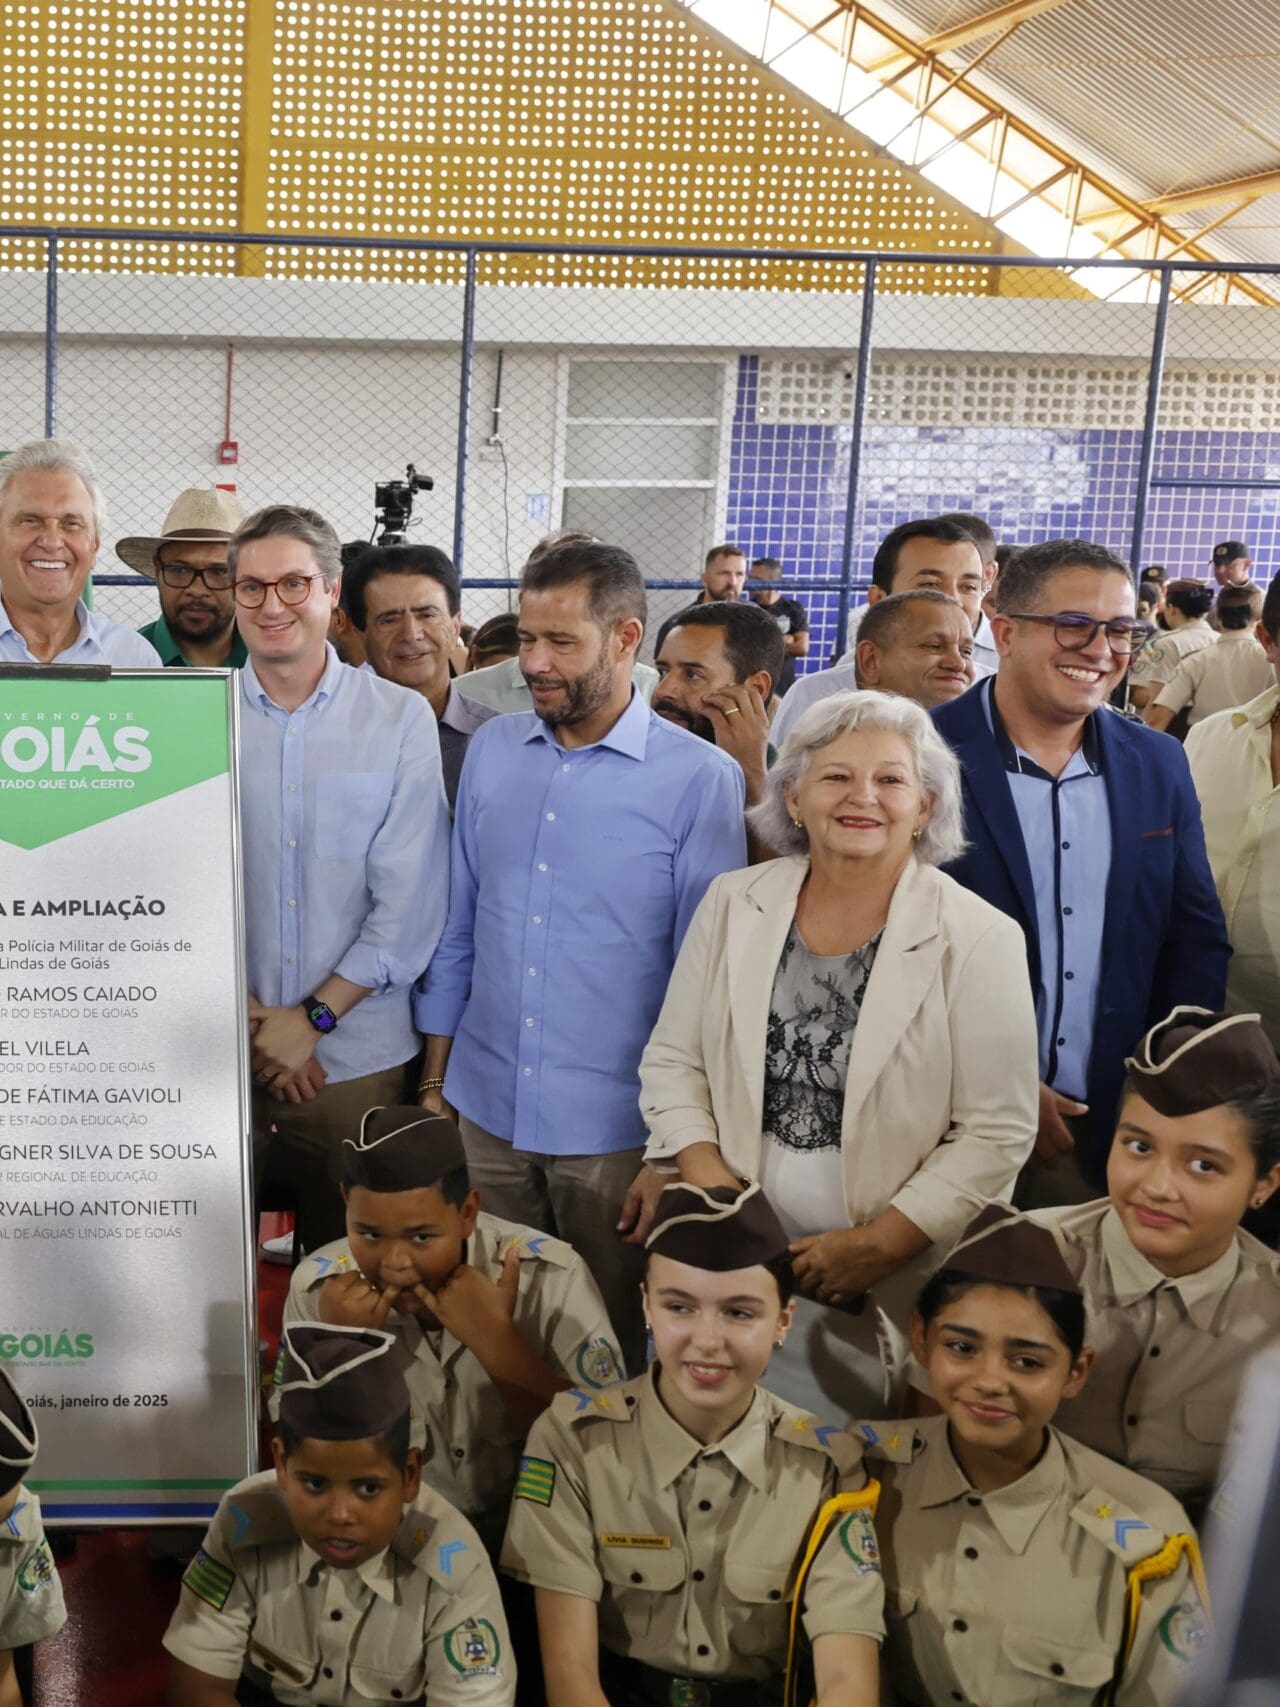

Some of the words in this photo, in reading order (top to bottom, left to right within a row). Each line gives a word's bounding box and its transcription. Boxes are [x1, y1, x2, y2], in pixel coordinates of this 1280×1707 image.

[110, 712, 134, 721] DE
[39, 779, 67, 790] QUE
[69, 778, 87, 789] DÁ
[91, 779, 135, 789] CERTO
[13, 900, 25, 917] E
[31, 896, 165, 920] AMPLIAÇÃO
[9, 939, 55, 953] Polícia
[59, 939, 104, 953] Militar
[108, 939, 126, 953] de
[130, 939, 170, 953] Goiás
[174, 939, 192, 953] de
[49, 957, 67, 970] de
[71, 957, 110, 970] Goiás
[7, 986, 78, 1002] RAMOS
[84, 986, 157, 1002] CAIADO
[12, 1009, 30, 1019] DO
[34, 1009, 80, 1019] ESTADO
[84, 1009, 98, 1019] DE
[102, 1007, 138, 1019] GOIÁS
[25, 1041, 89, 1056] VILELA
[27, 1063, 46, 1073] DO
[49, 1063, 95, 1073] ESTADO
[100, 1063, 114, 1073] DE
[118, 1061, 155, 1073] GOIÁS
[27, 1084, 99, 1104] FÁTIMA
[105, 1088, 181, 1104] GAVIOLI
[9, 1115, 57, 1126] ESTADO
[60, 1115, 78, 1126] DA
[81, 1113, 147, 1128] EDUCAÇÃO
[59, 1144, 113, 1161] SILVA
[119, 1144, 145, 1161] DE
[150, 1144, 217, 1160] SOUSA
[7, 1171, 67, 1183] REGIONAL
[71, 1171, 87, 1183] DE
[90, 1170, 157, 1185] EDUCAÇÃO
[80, 1200, 197, 1217] ANTONIETTI
[15, 1228, 30, 1240] DE
[33, 1226, 75, 1240] ÁGUAS
[79, 1228, 122, 1240] LINDAS
[126, 1228, 141, 1240] DE
[145, 1226, 182, 1240] GOIÁS
[23, 1394, 57, 1409] oiás,
[61, 1394, 109, 1410] janeiro
[113, 1394, 130, 1407] de
[134, 1394, 168, 1407] 2025
